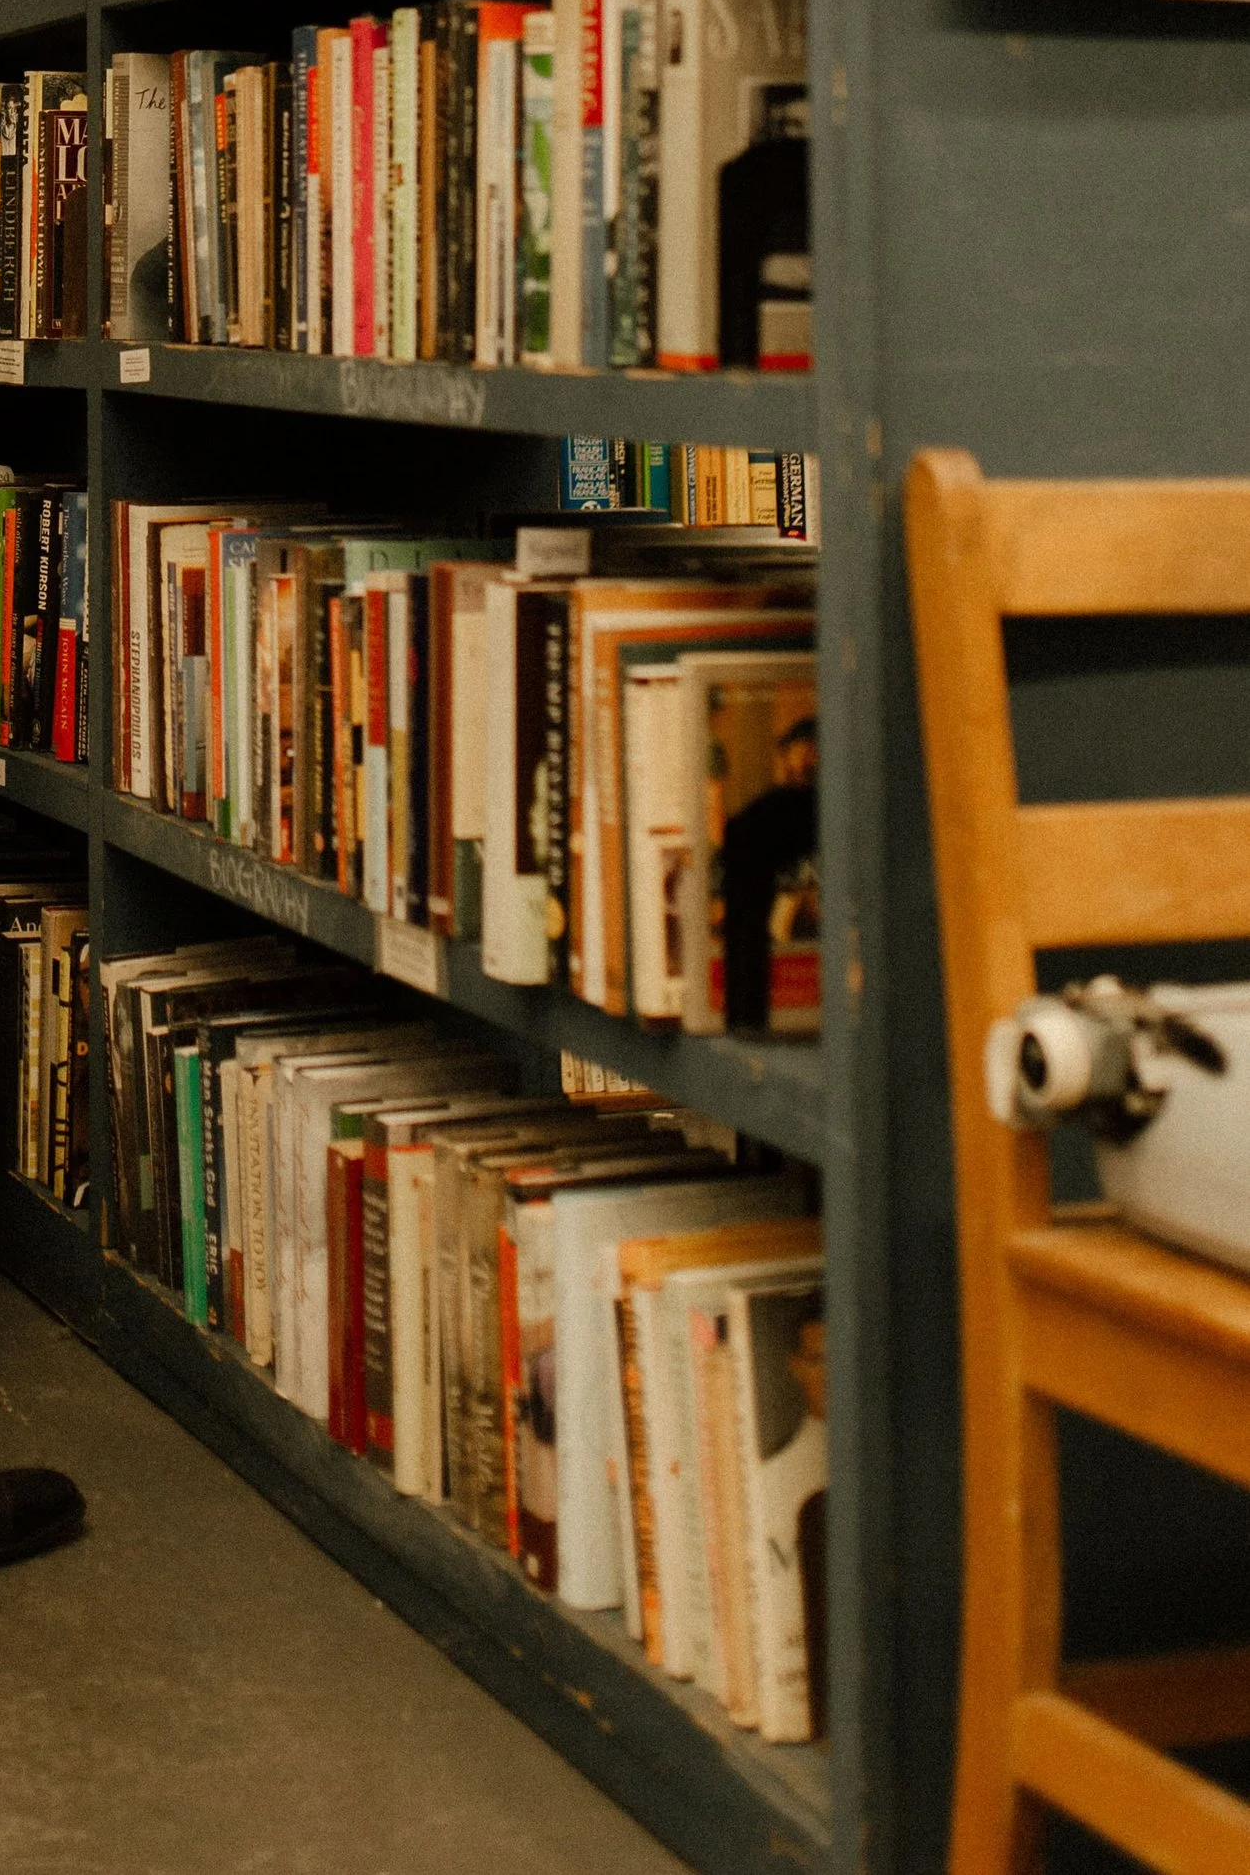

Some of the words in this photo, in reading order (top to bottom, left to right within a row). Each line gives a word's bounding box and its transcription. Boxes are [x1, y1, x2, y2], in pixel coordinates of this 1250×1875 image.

[297, 52, 309, 84] THE
[135, 86, 167, 112] The
[297, 160, 309, 202] MAN
[2, 169, 18, 303] LINDBERGH
[790, 452, 805, 528] GERMAN
[40, 498, 52, 553] ROBERT
[37, 555, 50, 611] KURSON
[60, 636, 70, 674] JOHN
[130, 630, 142, 761] STEPHANOPOULOS
[209, 845, 310, 937] BIOGRAPHY
[203, 1105, 214, 1162] Seeks
[248, 1098, 264, 1222] INVITATION
[205, 1169, 217, 1208] God
[207, 1231, 219, 1275] ERIC
[252, 1227, 266, 1253] TO
[253, 1255, 267, 1295] JOY
